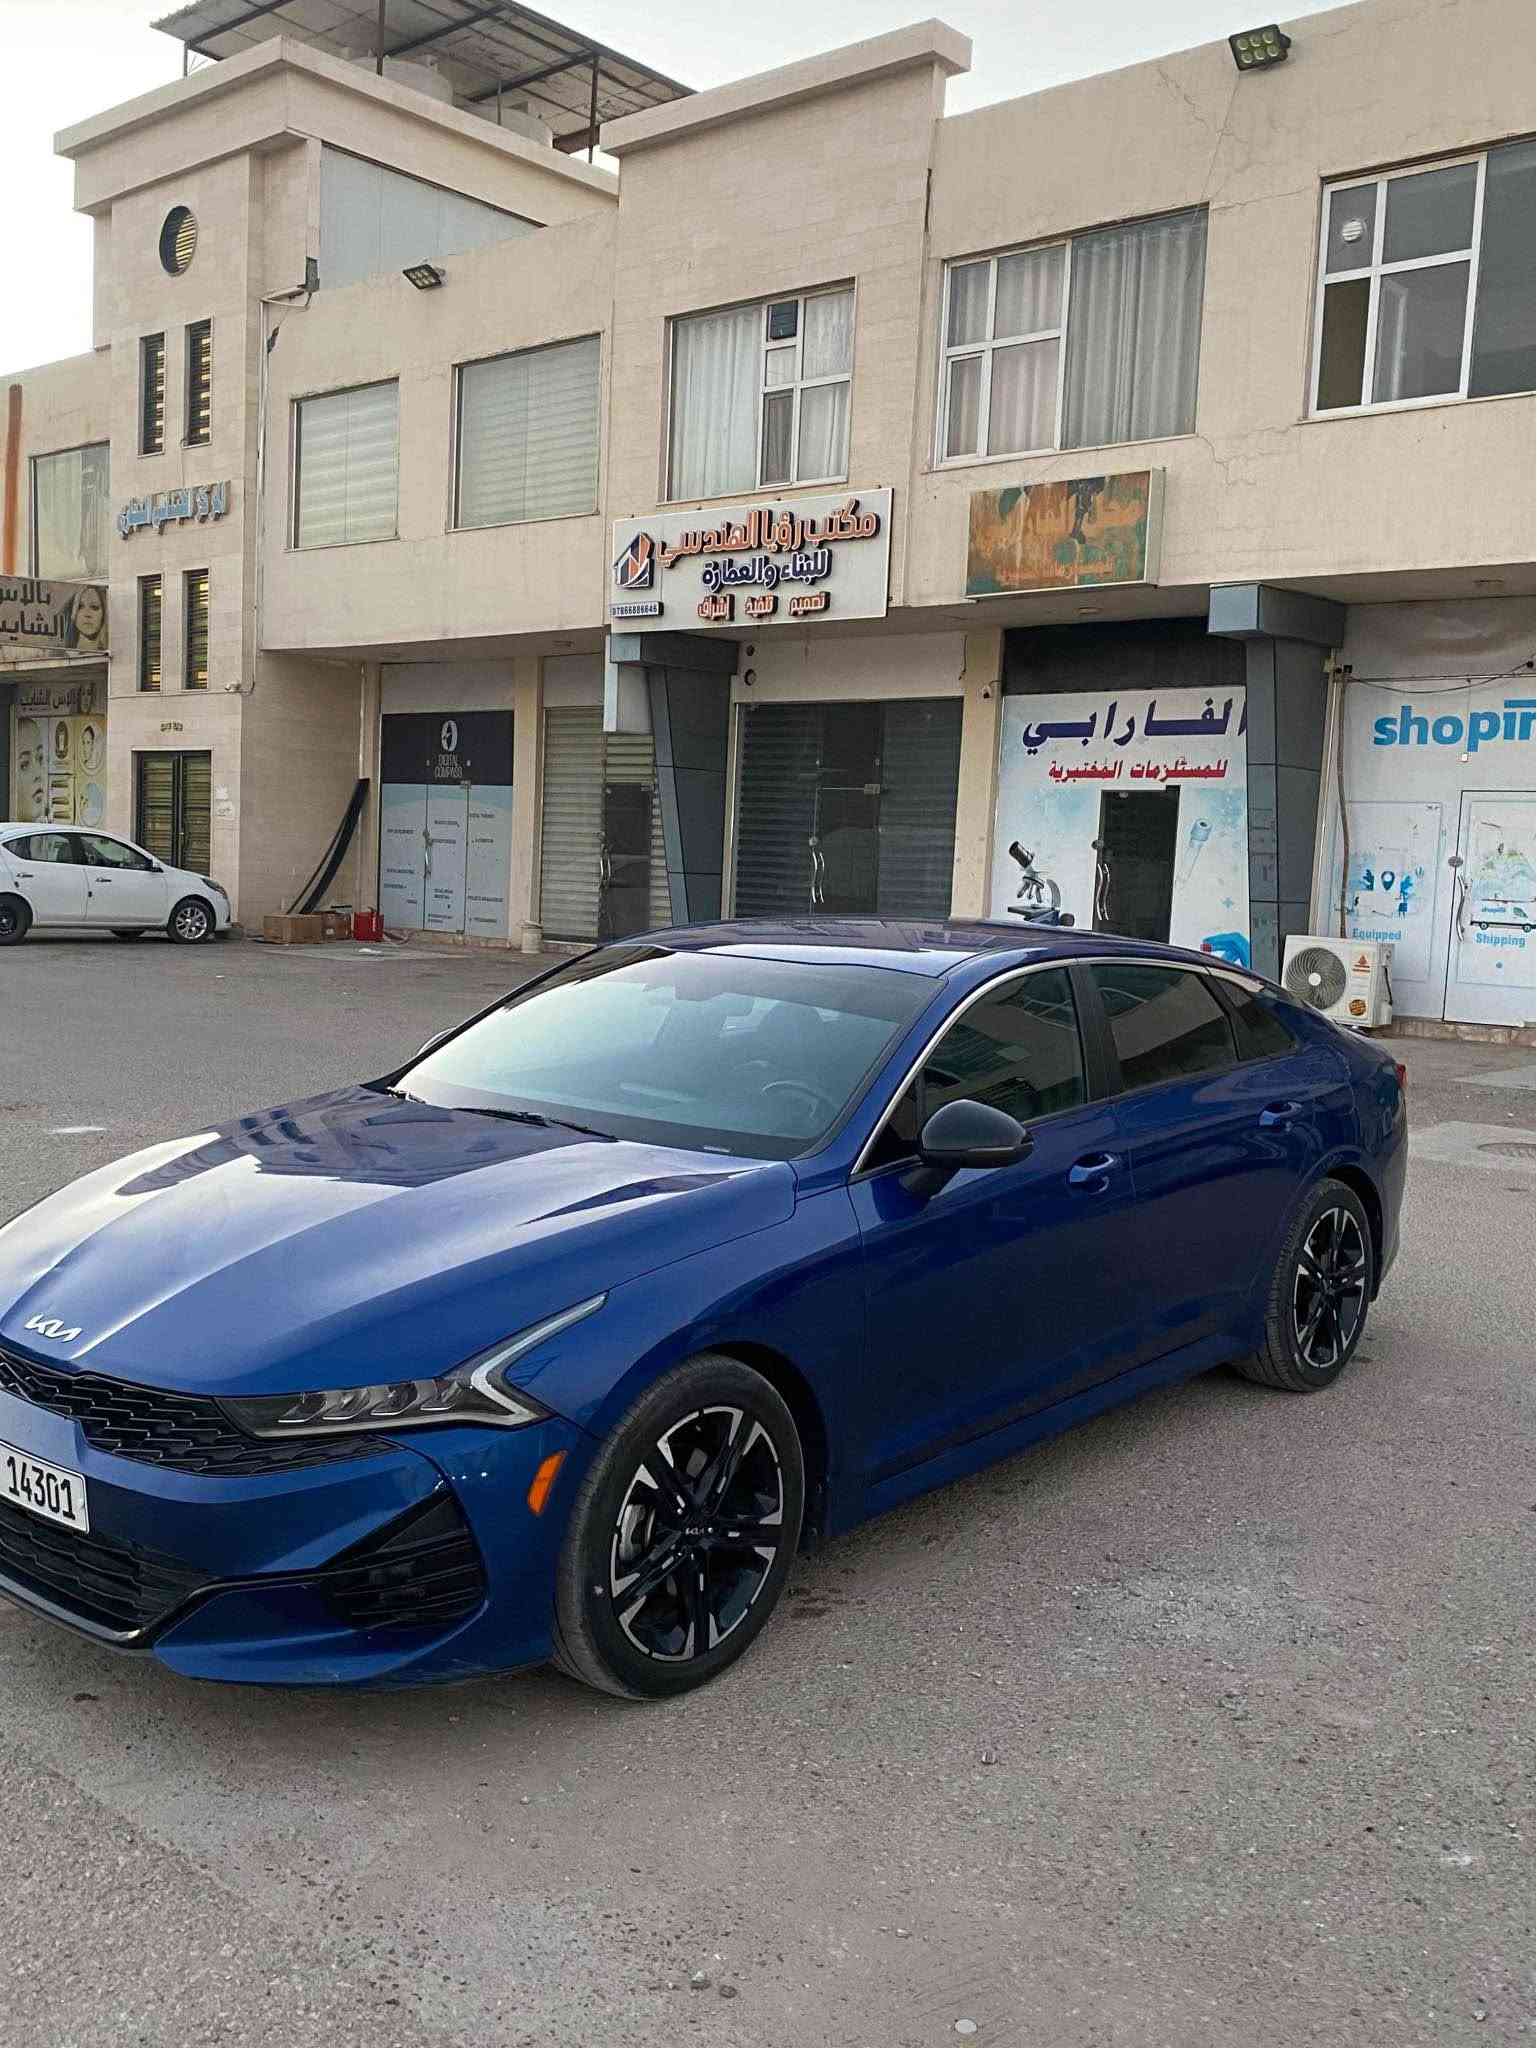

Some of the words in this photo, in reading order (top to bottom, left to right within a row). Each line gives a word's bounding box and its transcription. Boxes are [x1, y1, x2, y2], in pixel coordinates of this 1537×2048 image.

[762, 509, 803, 552] رؤيا
[804, 499, 881, 545] مكتب
[656, 511, 768, 569] الهندسي
[702, 556, 778, 592] والعمارة
[780, 549, 832, 584] للبناء
[789, 592, 830, 616] تصميم
[1022, 697, 1247, 756] الفارابي
[1048, 759, 1124, 783] المختبرية
[1129, 758, 1228, 782] للمستلزمات
[1352, 927, 1402, 942] Equipped
[1476, 932, 1526, 949] Shipping
[7, 1455, 76, 1521] 14301
